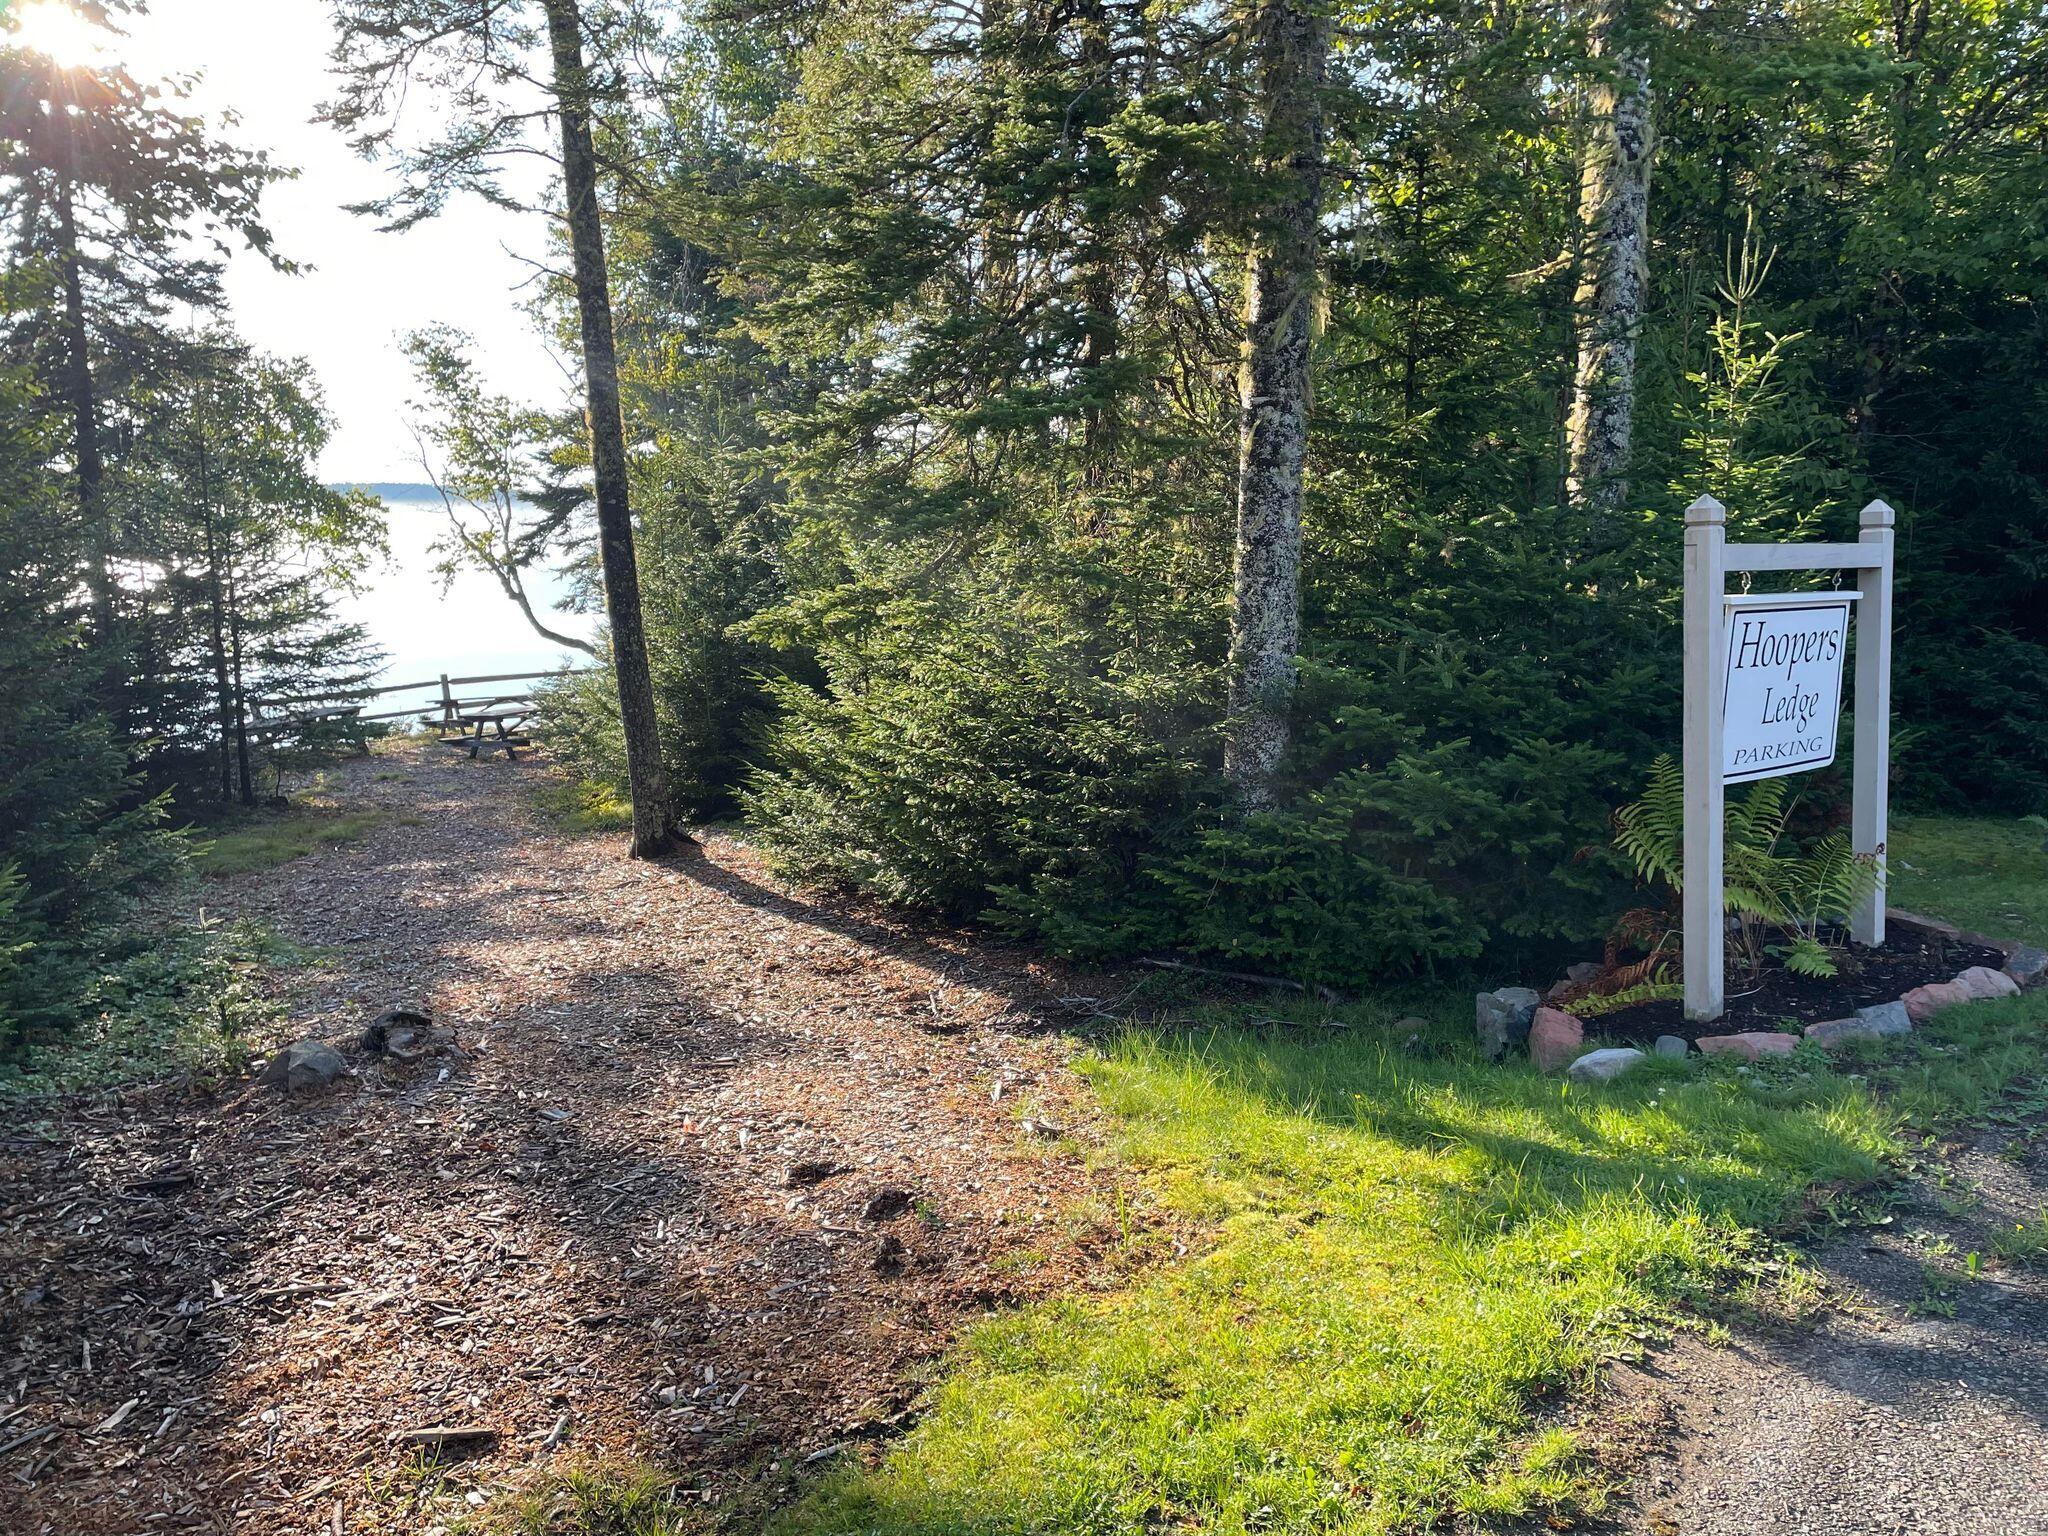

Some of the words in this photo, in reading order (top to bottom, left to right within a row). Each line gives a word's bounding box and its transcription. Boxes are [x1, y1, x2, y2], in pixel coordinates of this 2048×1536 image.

[1734, 621, 1839, 681] Hoopers
[1761, 684, 1819, 733] Ledge
[1733, 736, 1823, 765] PARKING
